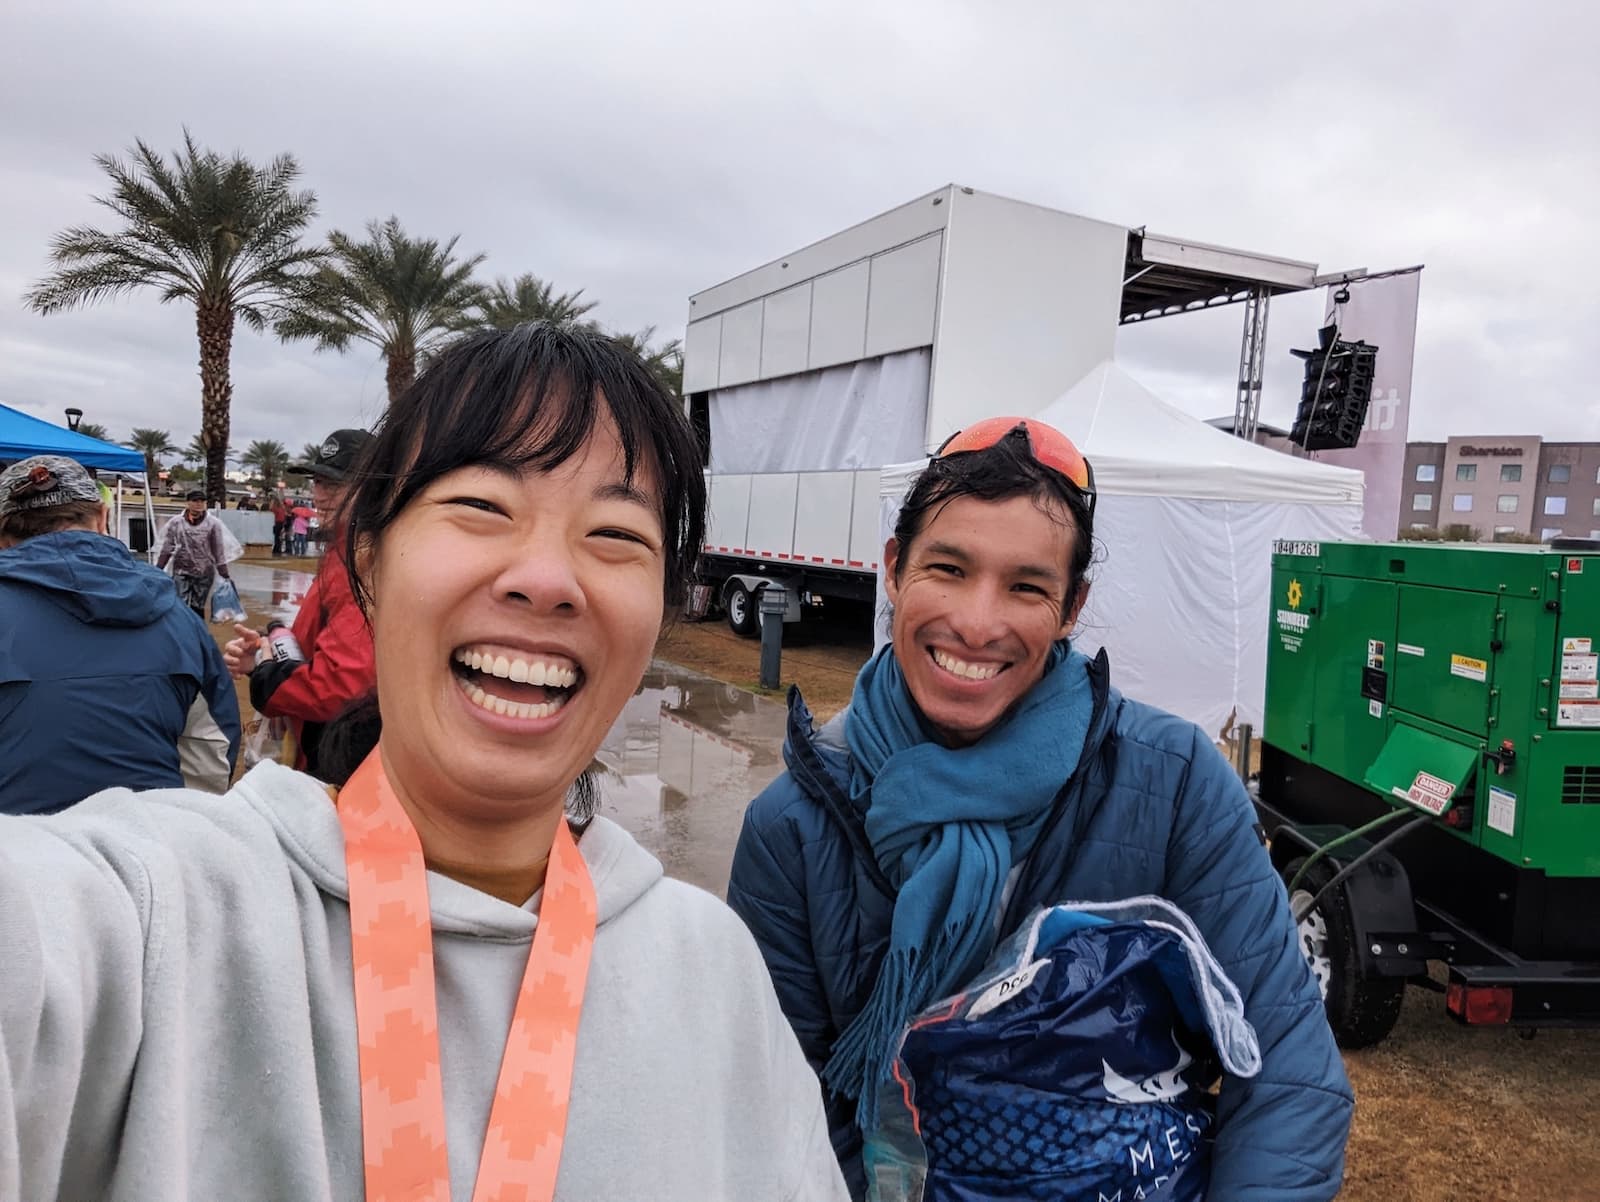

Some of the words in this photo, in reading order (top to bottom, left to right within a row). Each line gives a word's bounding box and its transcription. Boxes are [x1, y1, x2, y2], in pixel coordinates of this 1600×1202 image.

[1459, 445, 1523, 457] Sheraton
[1272, 541, 1319, 556] 10401261
[1129, 1114, 1202, 1176] MES
